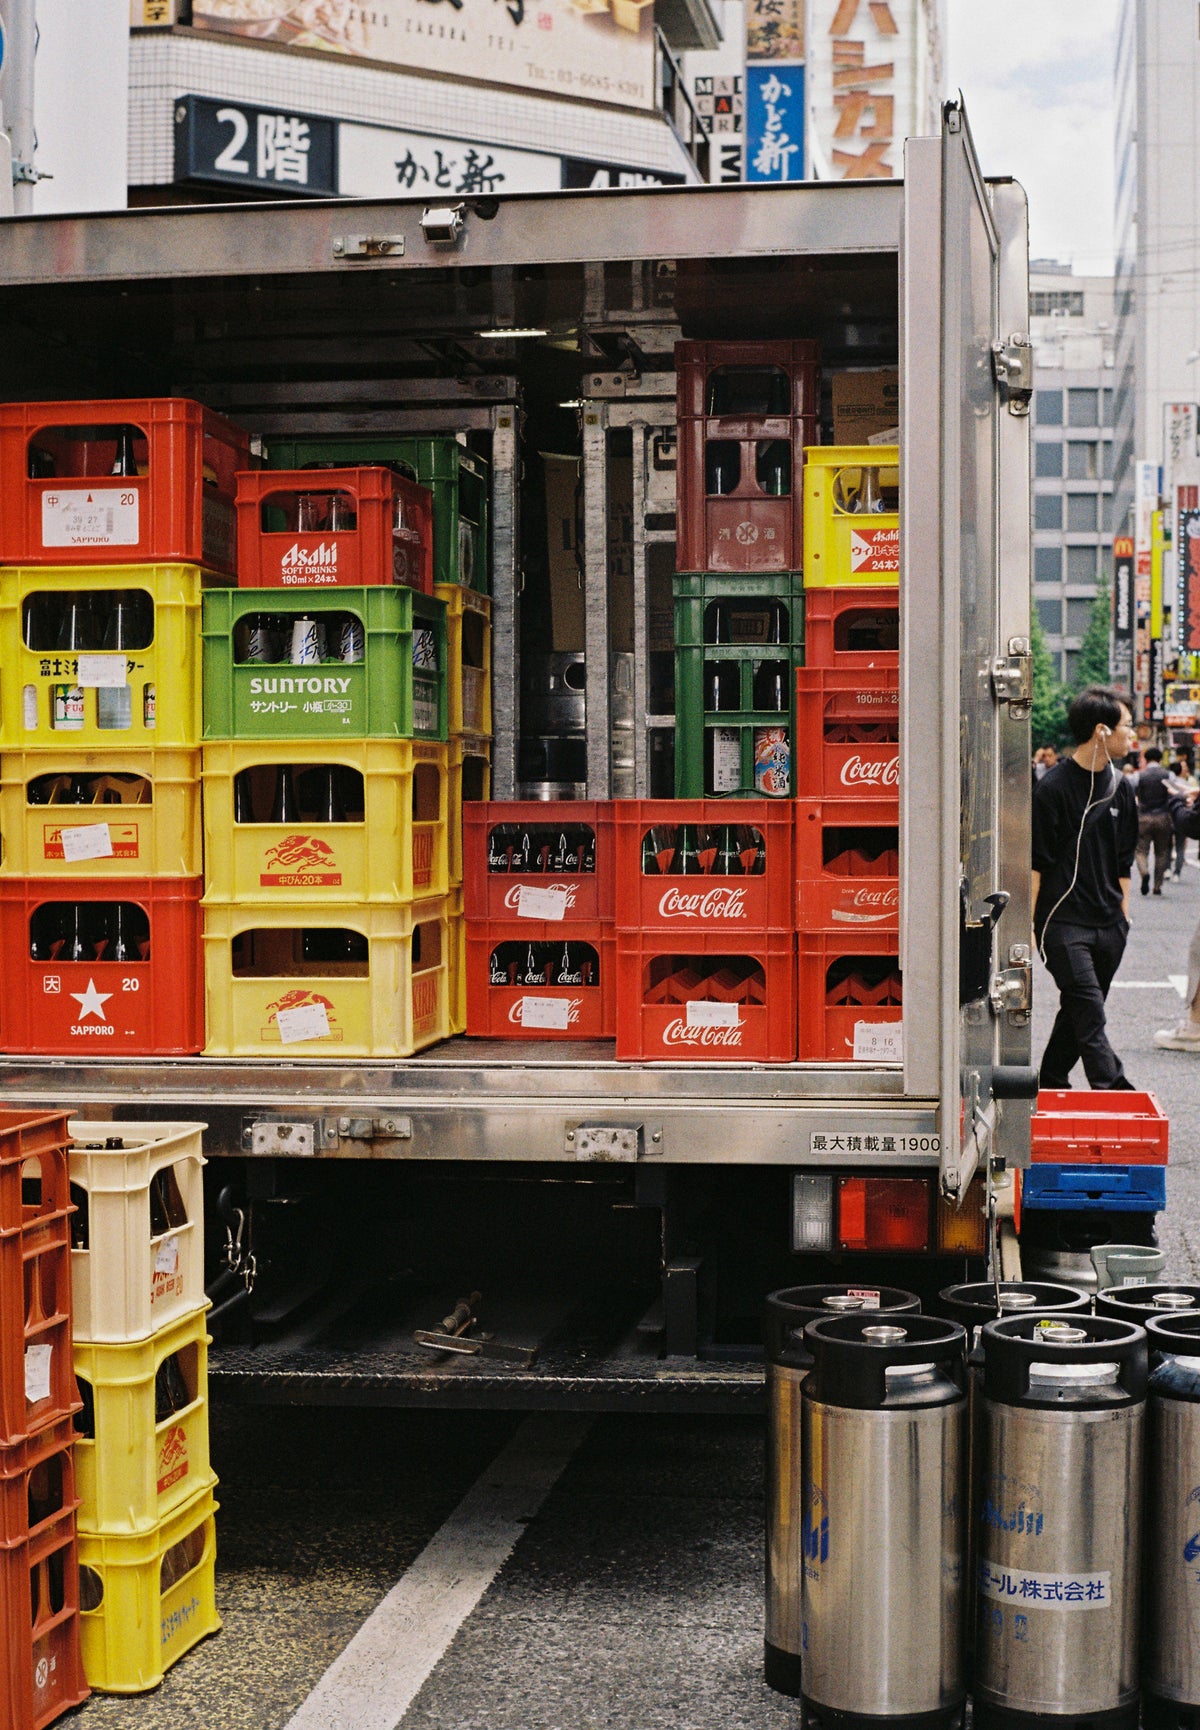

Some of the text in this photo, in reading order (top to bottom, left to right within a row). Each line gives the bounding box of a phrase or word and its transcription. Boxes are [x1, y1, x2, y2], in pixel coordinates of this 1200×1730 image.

[752, 73, 799, 182] かど新
[213, 108, 311, 184] 2階
[393, 147, 506, 193] かど新
[120, 493, 135, 506] 20
[281, 541, 337, 567] Asahi
[281, 565, 337, 575] SOFT DRINKS
[250, 677, 352, 694] SUNTORY
[250, 700, 298, 713] サントリー
[278, 875, 324, 885] 中びん20本
[658, 887, 748, 919] Coca-Cola
[121, 977, 140, 992] 20
[70, 1025, 115, 1036] SAPPORO
